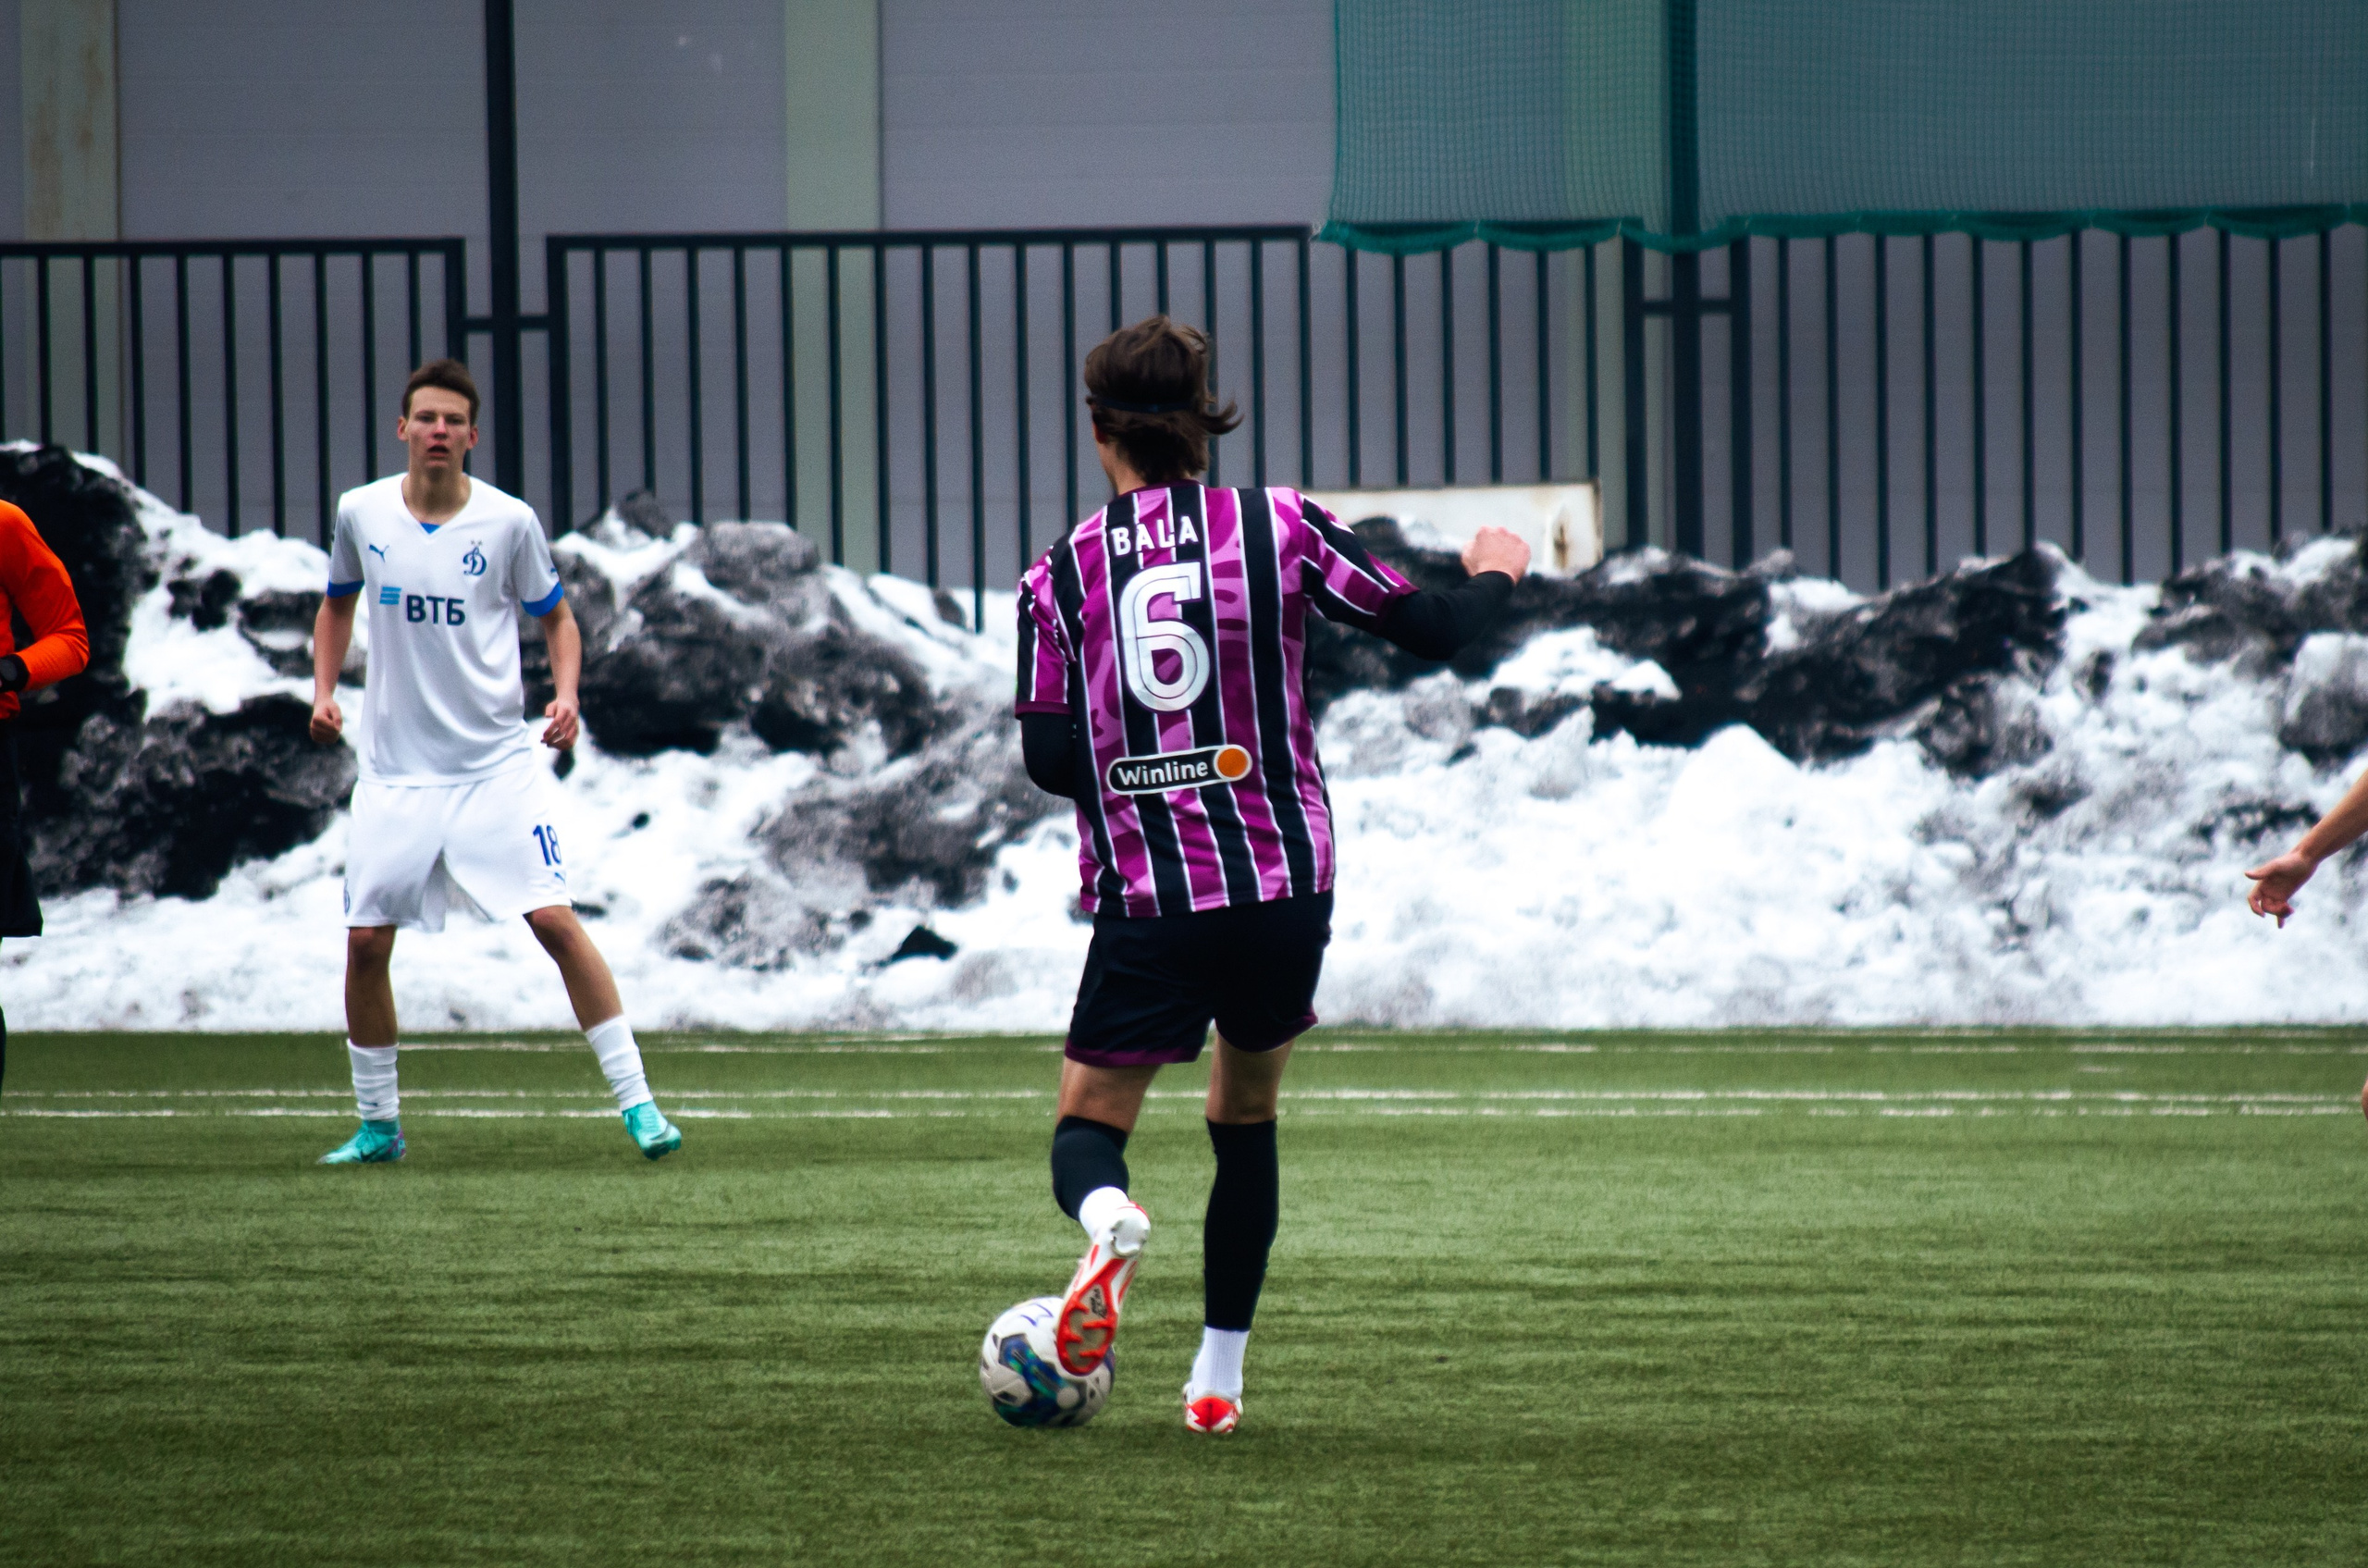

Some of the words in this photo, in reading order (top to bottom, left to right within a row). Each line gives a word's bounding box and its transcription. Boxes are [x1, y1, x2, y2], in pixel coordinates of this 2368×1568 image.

[1111, 515, 1199, 556] BALA
[406, 595, 466, 626] ВТБ
[1118, 561, 1210, 712] 6
[1117, 760, 1209, 785] Winline
[533, 824, 562, 866] 18
